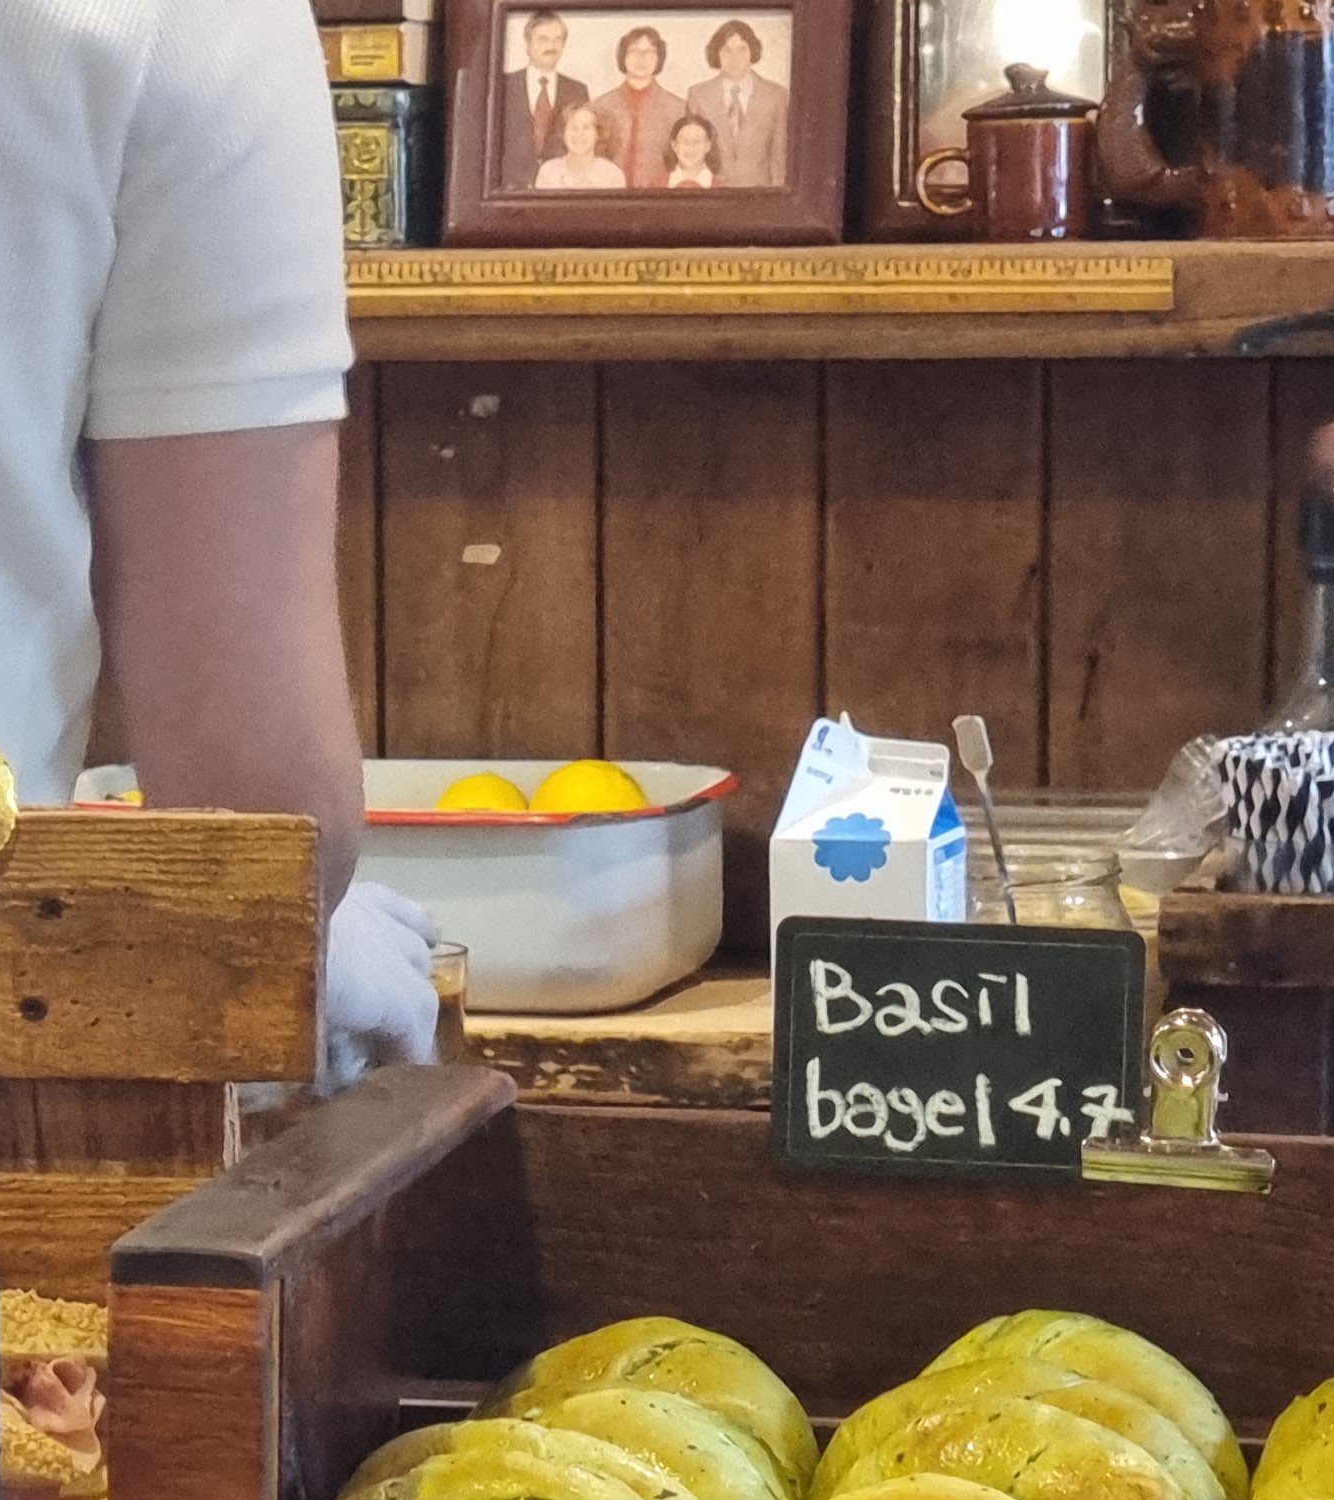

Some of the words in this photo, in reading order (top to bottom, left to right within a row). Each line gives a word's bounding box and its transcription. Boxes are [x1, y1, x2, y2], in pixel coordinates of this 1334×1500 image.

[809, 958, 1032, 1036] Basil
[806, 1056, 996, 1152] bagel
[1007, 1078, 1135, 1141] 4.7
